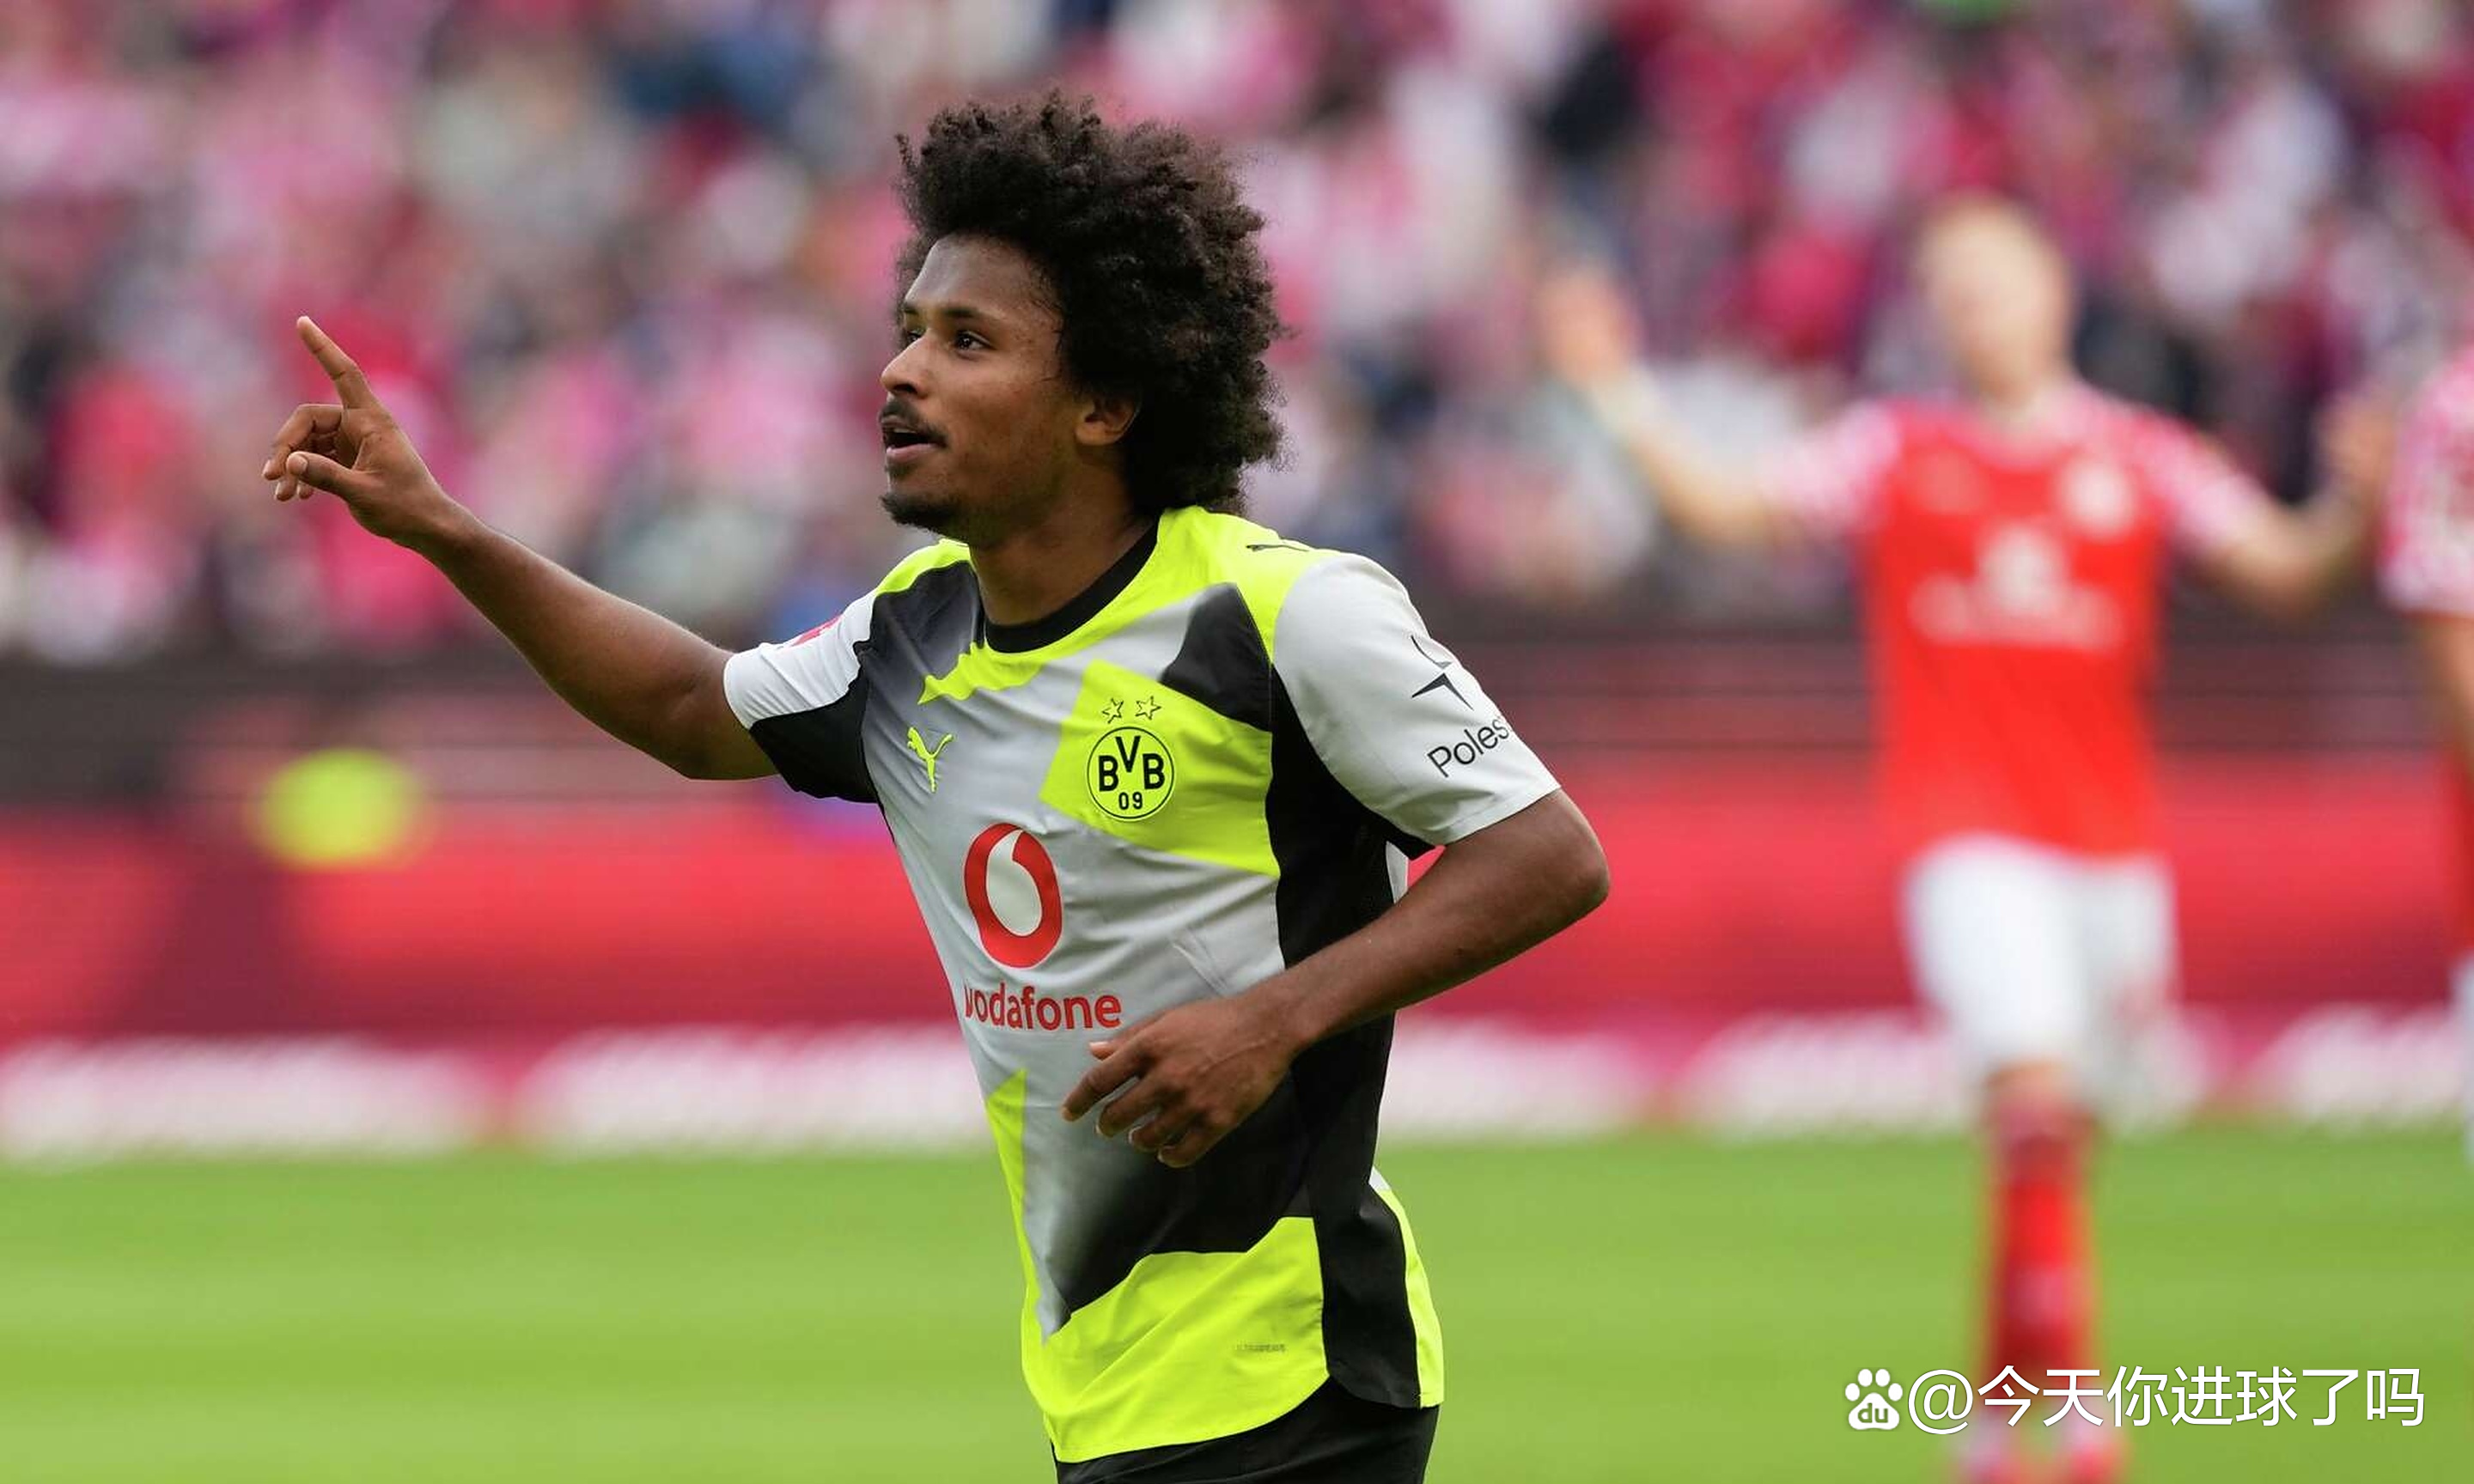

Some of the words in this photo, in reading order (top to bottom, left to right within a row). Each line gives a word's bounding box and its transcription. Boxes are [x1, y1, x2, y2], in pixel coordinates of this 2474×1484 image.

[1098, 735, 1166, 792] BVB
[1118, 791, 1143, 811] 09
[964, 982, 1123, 1031] vodafone
